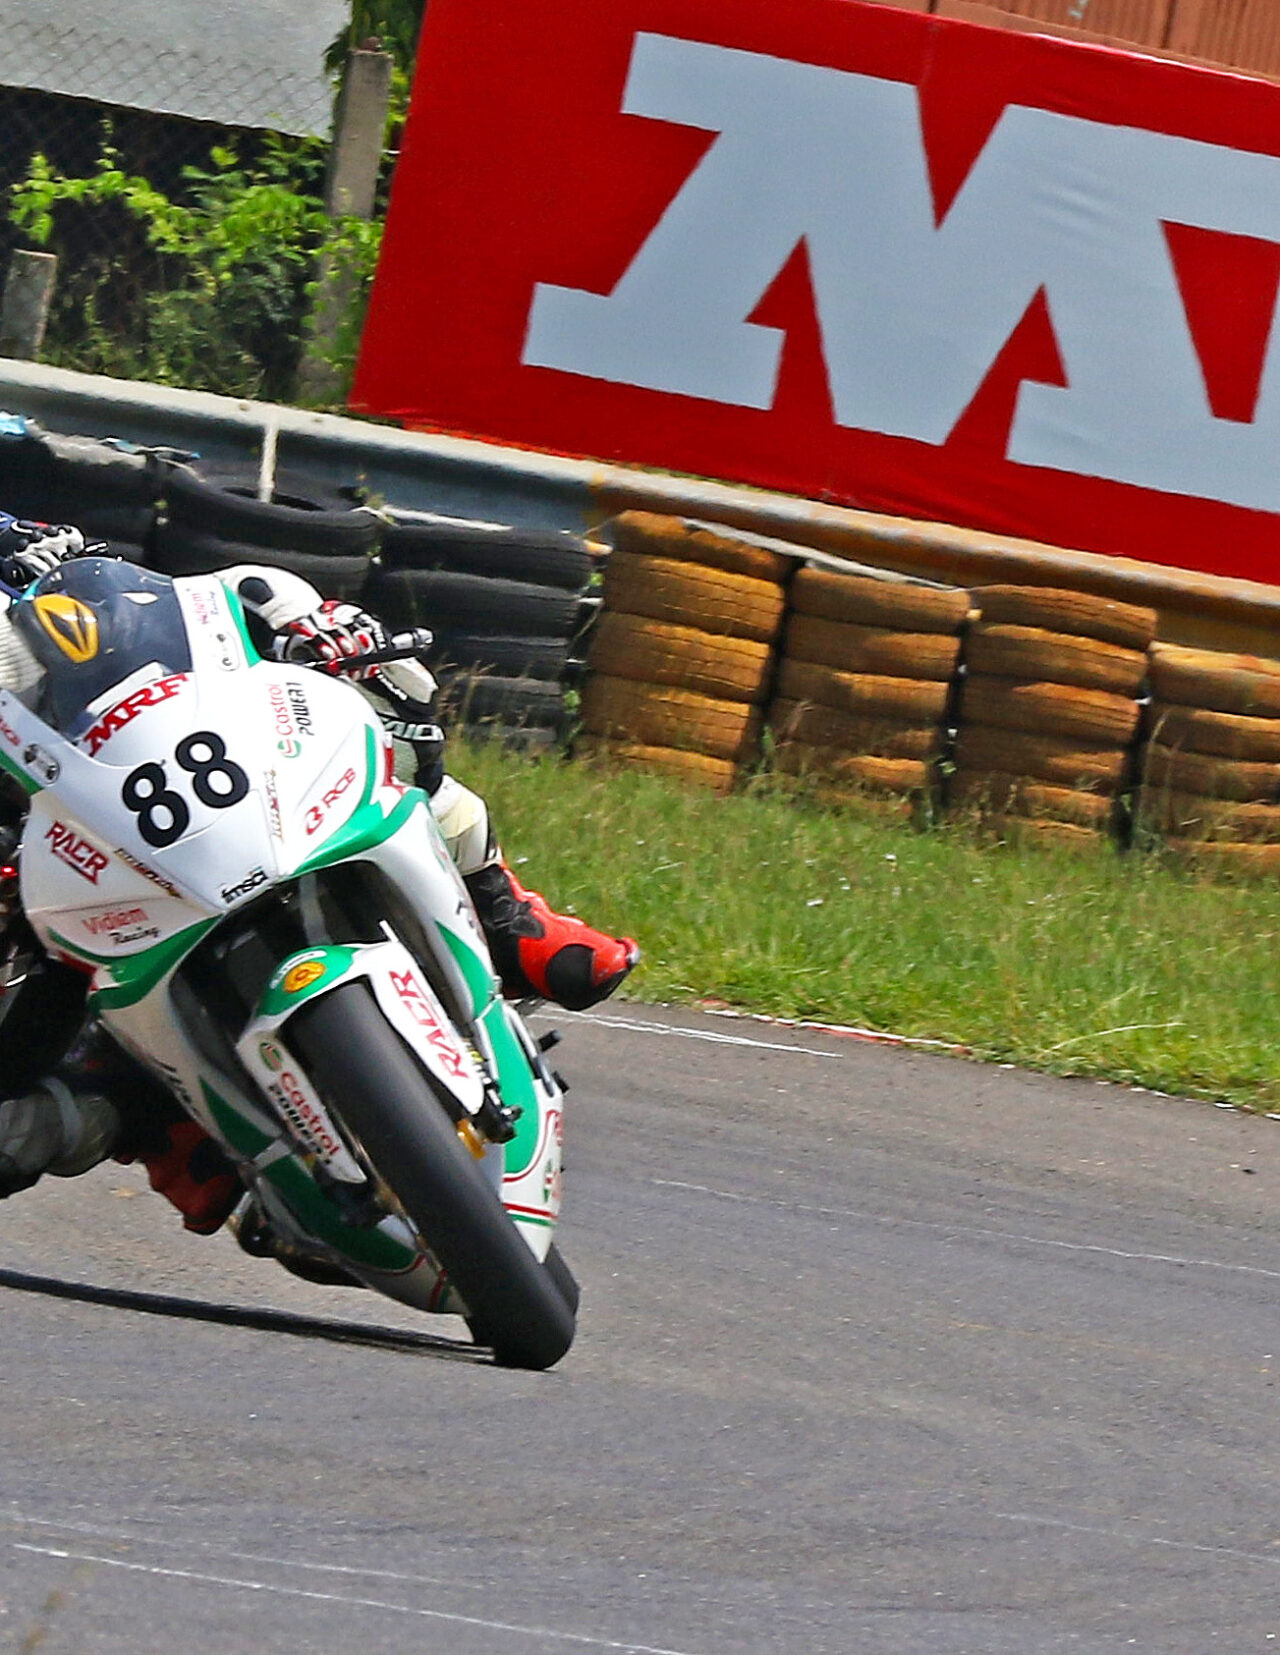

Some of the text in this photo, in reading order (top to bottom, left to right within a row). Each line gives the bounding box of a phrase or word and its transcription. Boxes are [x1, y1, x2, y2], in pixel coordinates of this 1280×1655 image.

[82, 672, 189, 759] MRF
[264, 682, 294, 737] Castrol
[122, 731, 250, 848] 88
[44, 820, 110, 886] RACR
[81, 907, 149, 935] Vidiem
[107, 925, 161, 945] Racing
[387, 968, 470, 1079] RACR
[280, 1071, 342, 1157] Castrol
